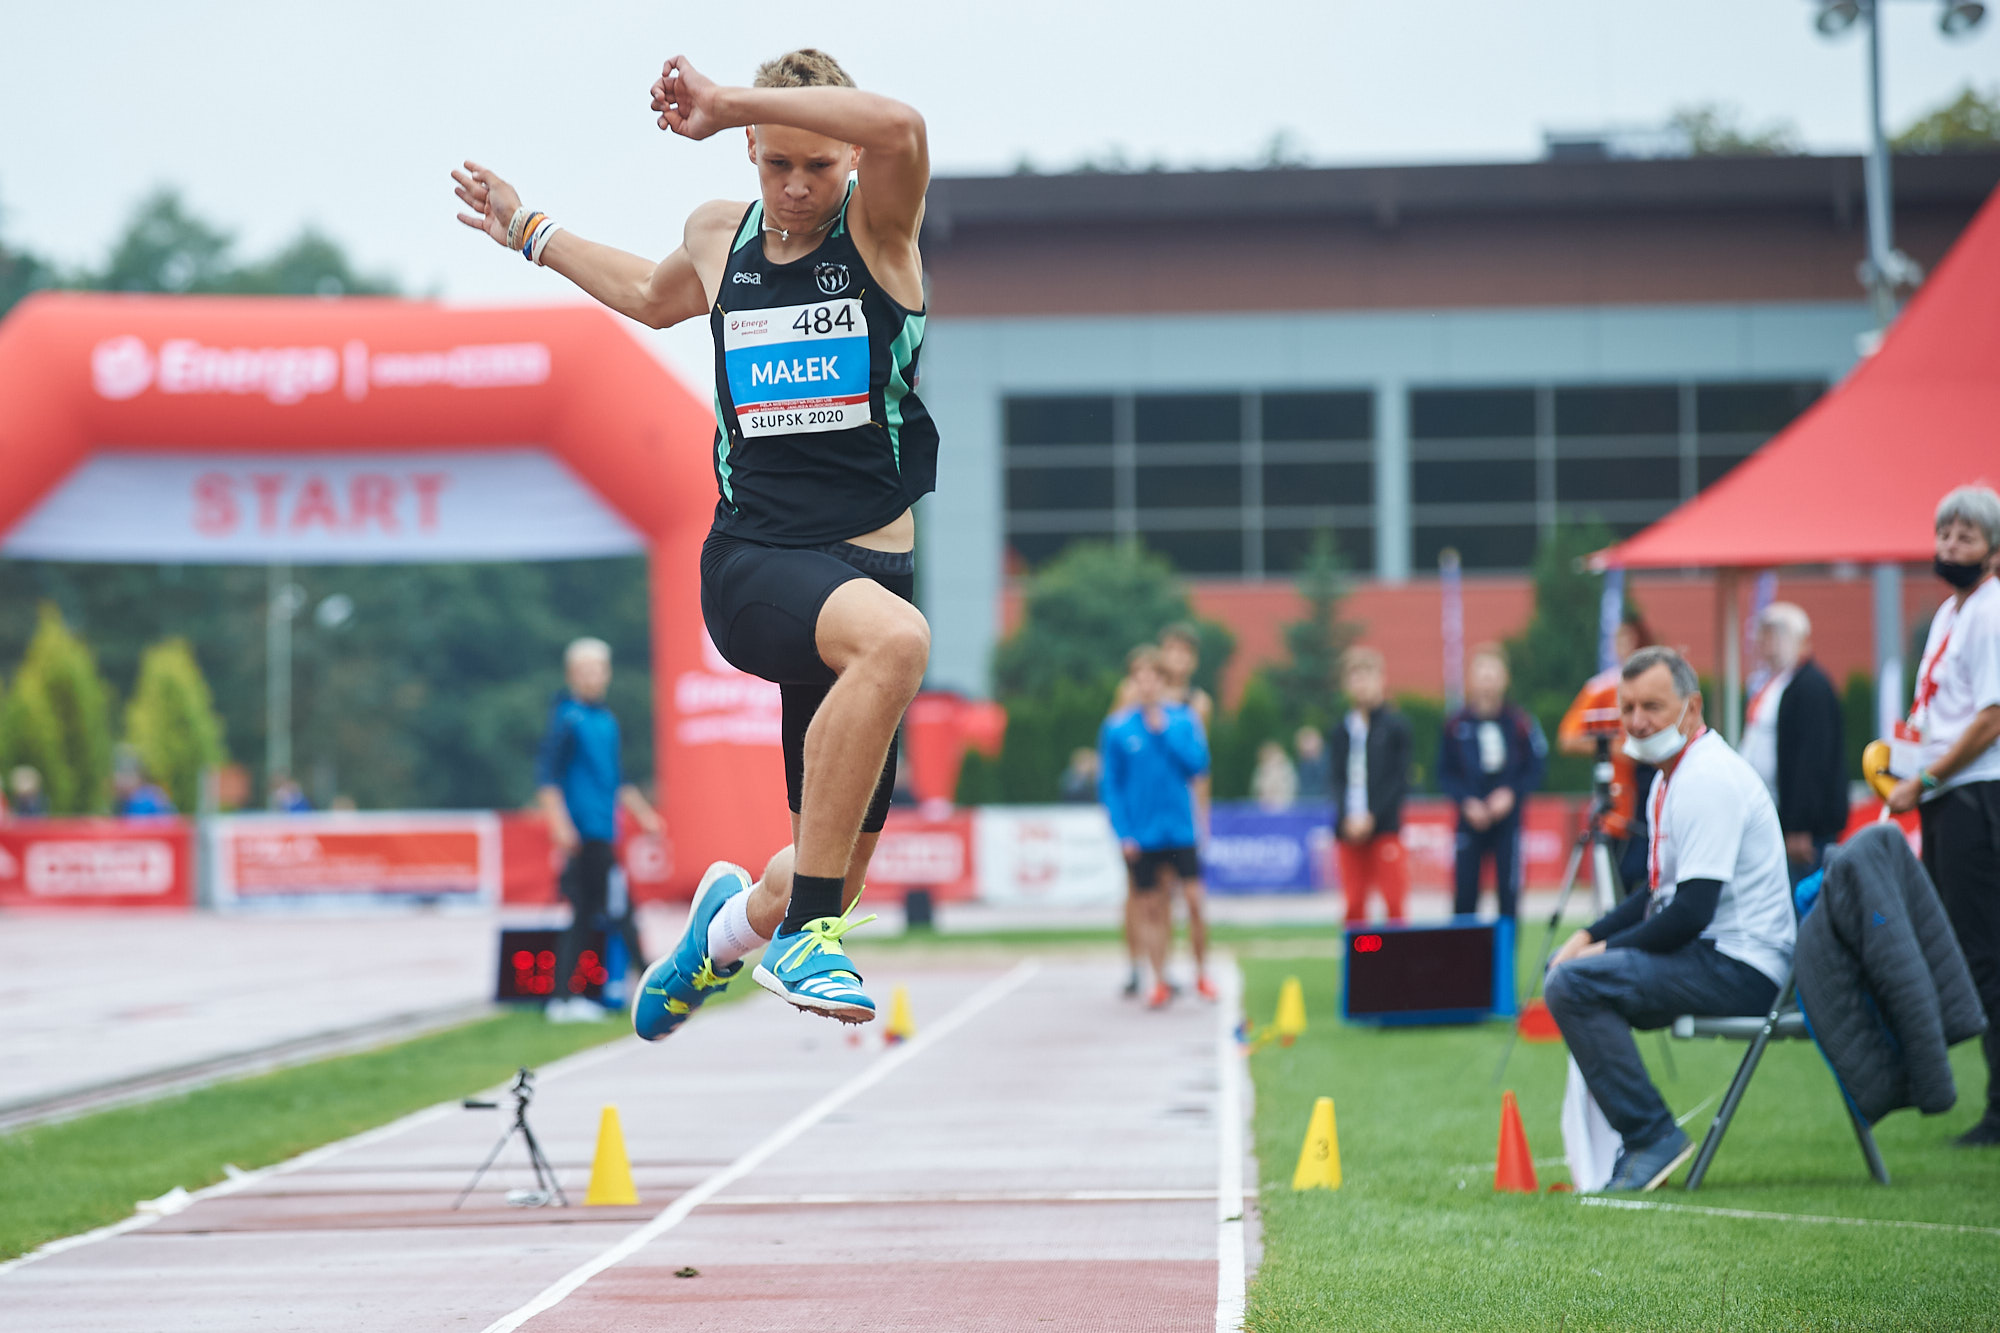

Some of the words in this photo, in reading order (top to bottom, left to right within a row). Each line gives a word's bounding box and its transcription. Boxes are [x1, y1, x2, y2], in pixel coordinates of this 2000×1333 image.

[792, 304, 855, 336] 484
[751, 355, 841, 387] MAŁEK
[751, 413, 804, 429] SŁUPSK
[808, 409, 844, 424] 2020
[192, 471, 449, 536] START
